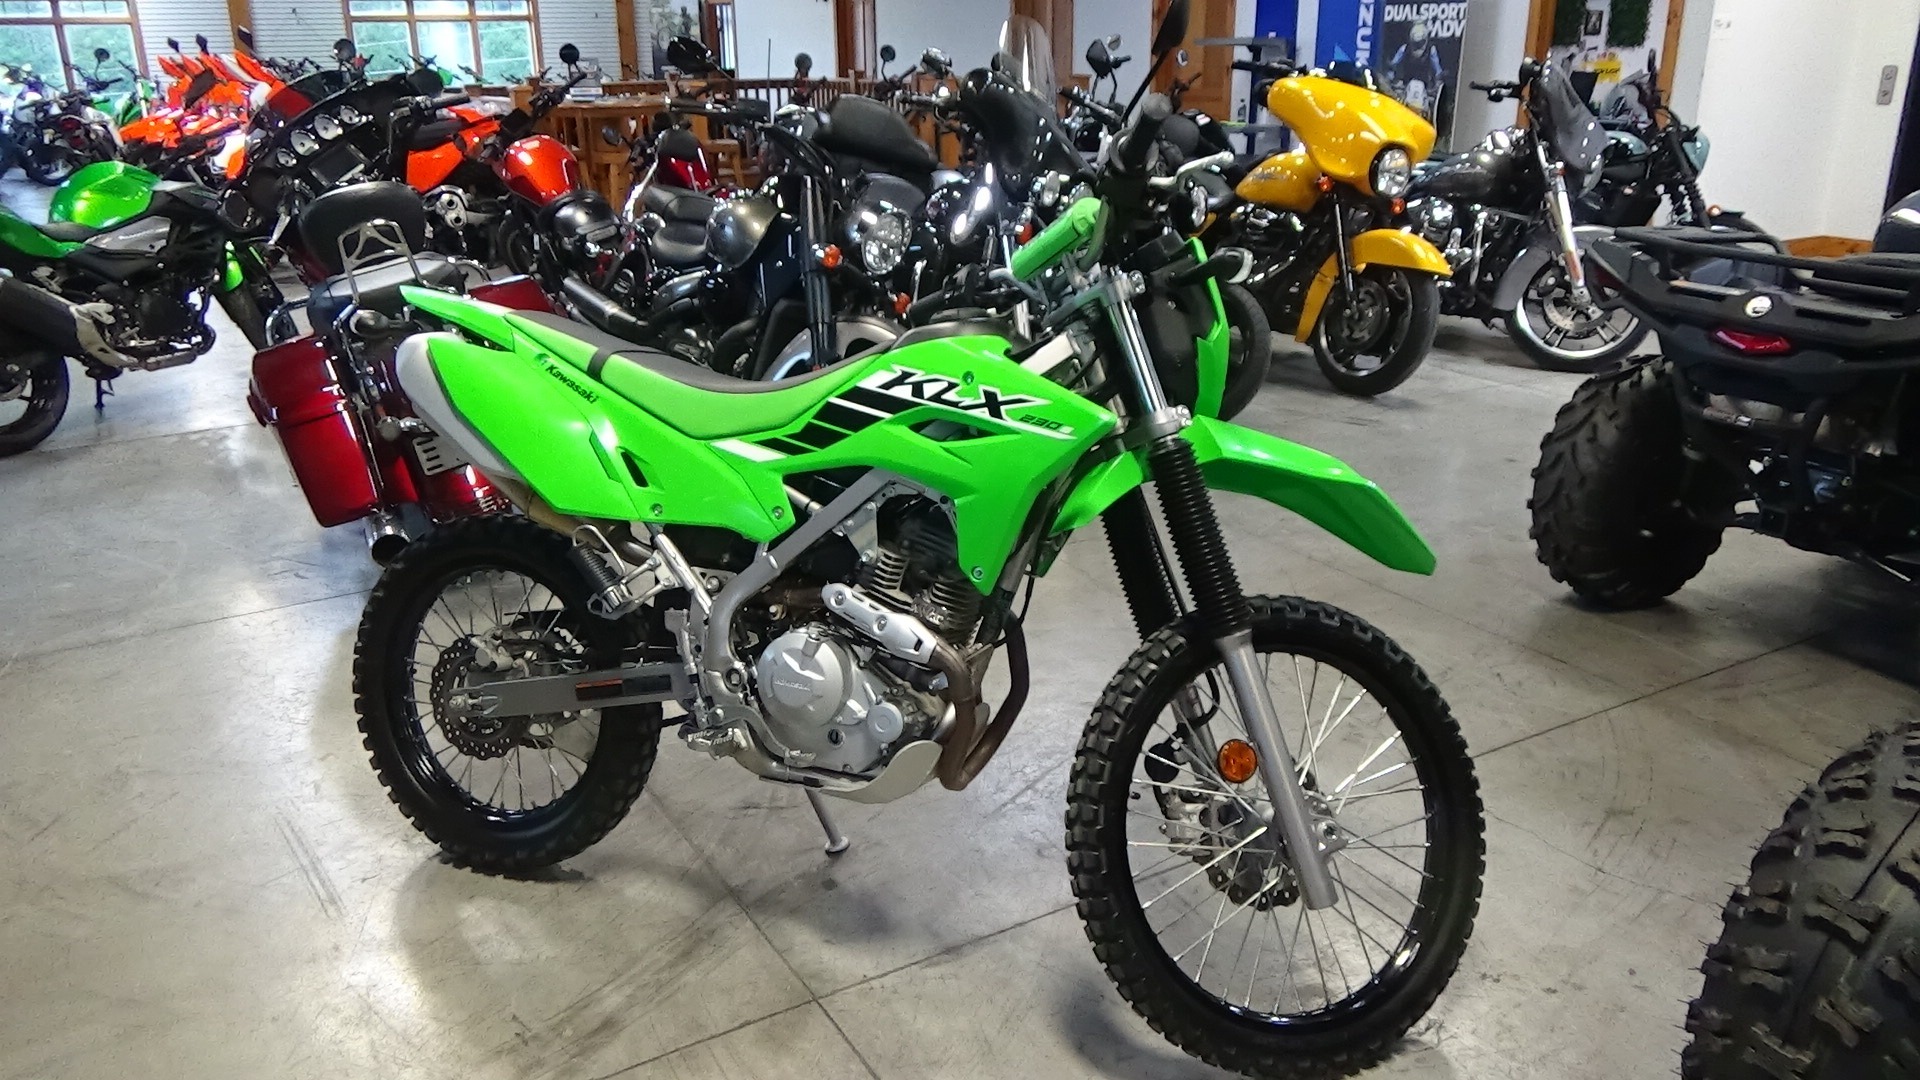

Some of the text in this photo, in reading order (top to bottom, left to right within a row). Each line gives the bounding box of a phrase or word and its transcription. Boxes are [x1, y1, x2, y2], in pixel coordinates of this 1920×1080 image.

[1384, 3, 1468, 22] DUALSPORT
[1355, 0, 1375, 67] ZUK
[545, 364, 600, 404] Kawasaki
[876, 365, 1048, 422] KLX
[1019, 414, 1064, 430] 230
